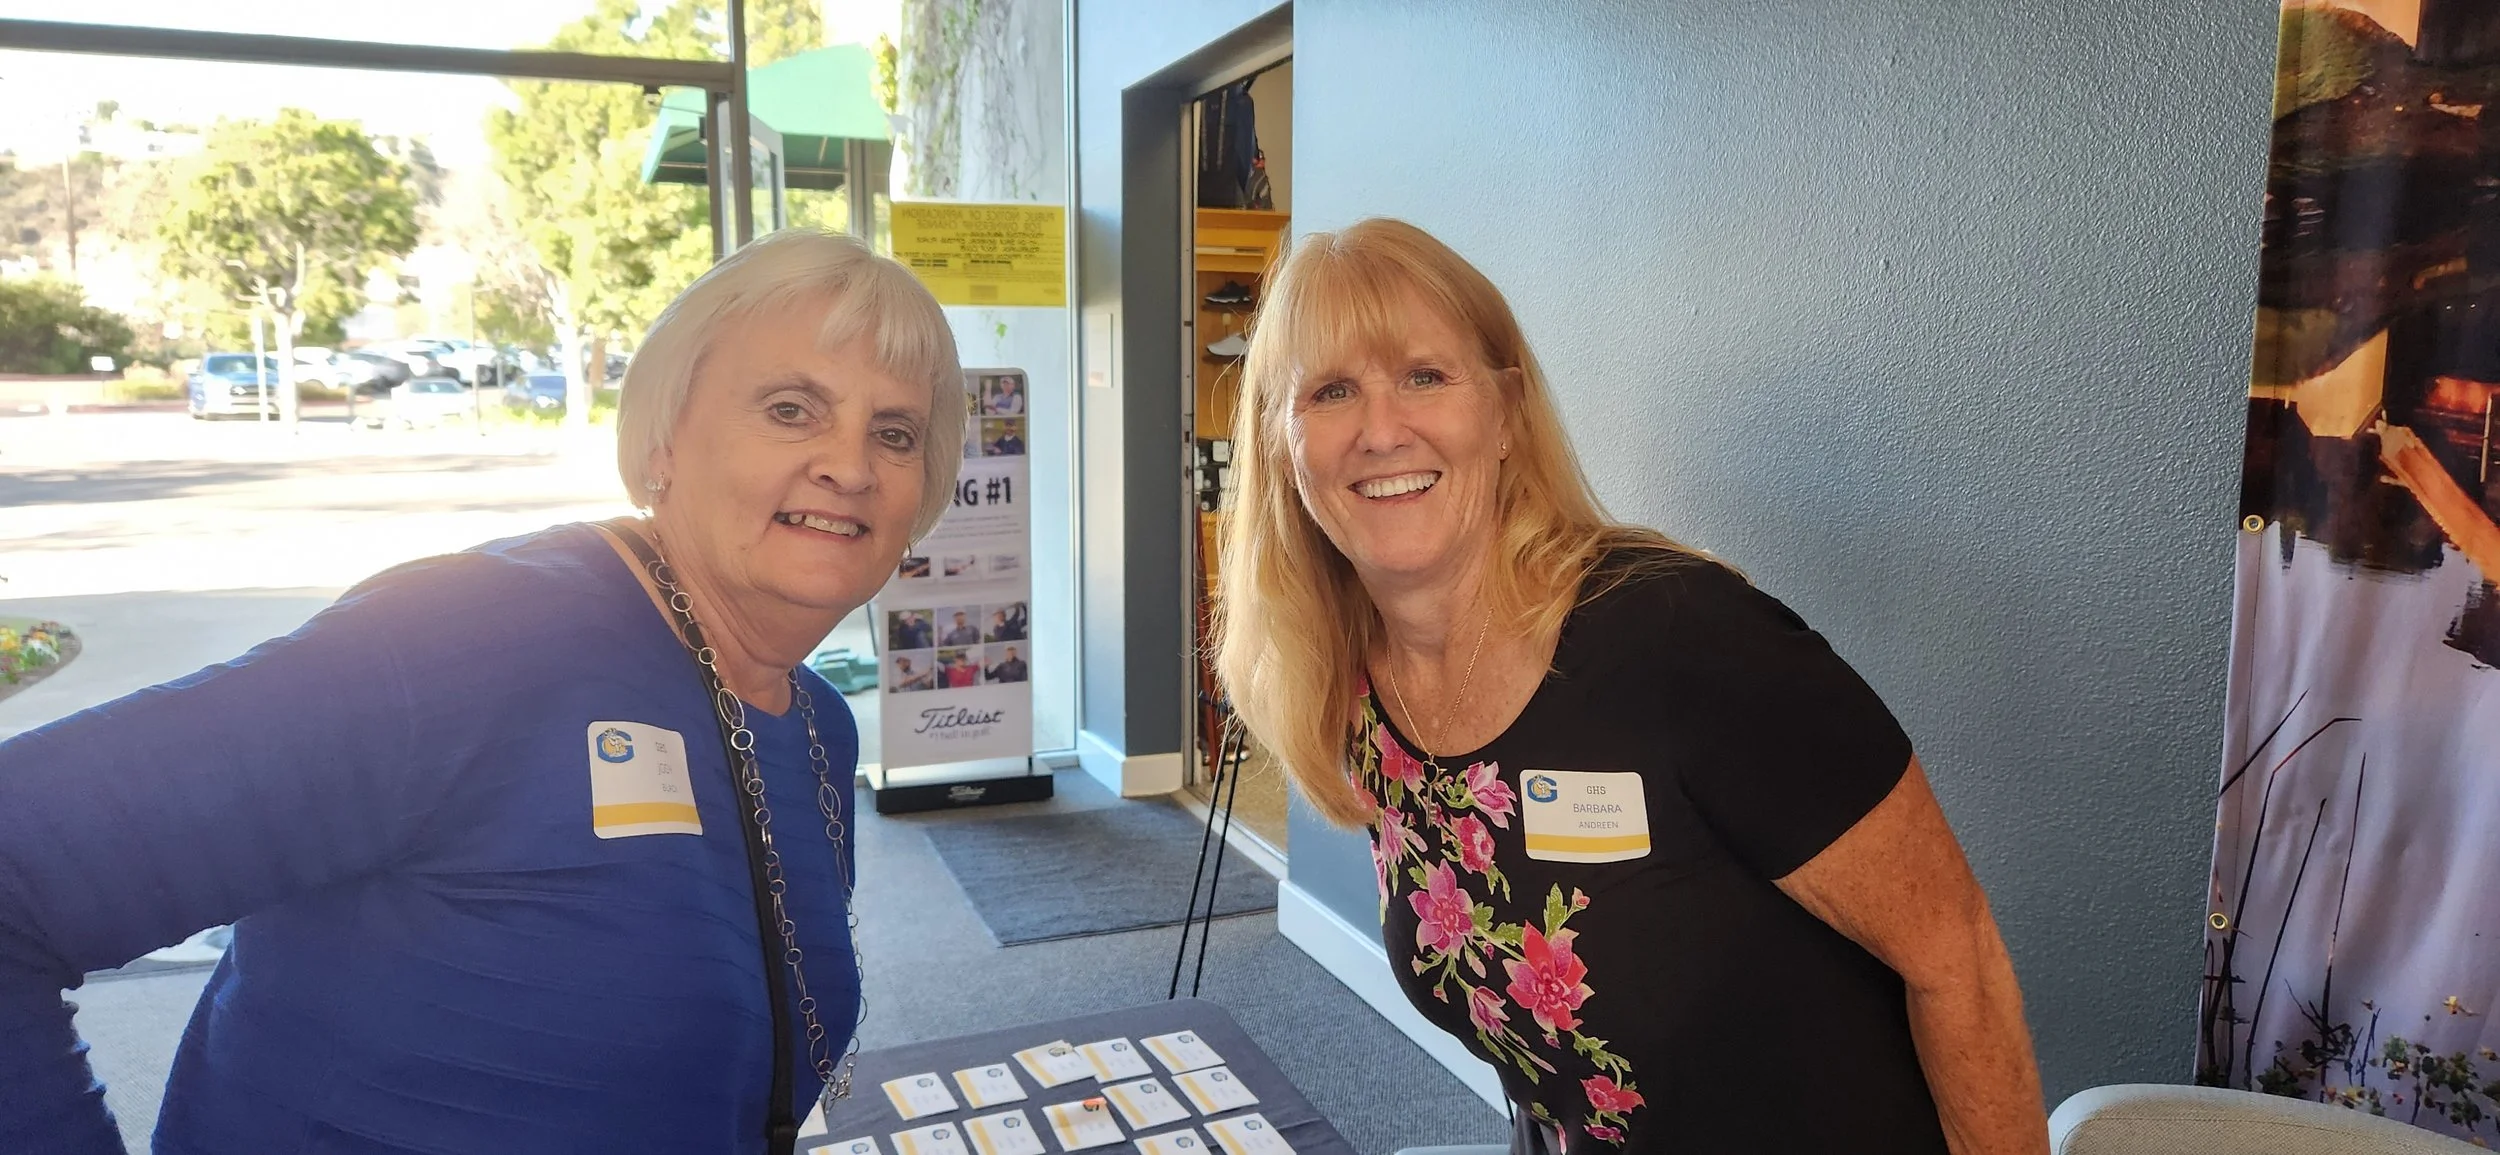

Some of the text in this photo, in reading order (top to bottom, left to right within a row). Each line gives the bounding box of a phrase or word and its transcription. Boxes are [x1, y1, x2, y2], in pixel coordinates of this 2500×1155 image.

[986, 476, 1012, 506] #1
[914, 704, 1006, 734] Titleist
[1586, 785, 1606, 795] GHS
[1573, 803, 1623, 814] BARBARA
[1578, 821, 1619, 830] ANDREEN
